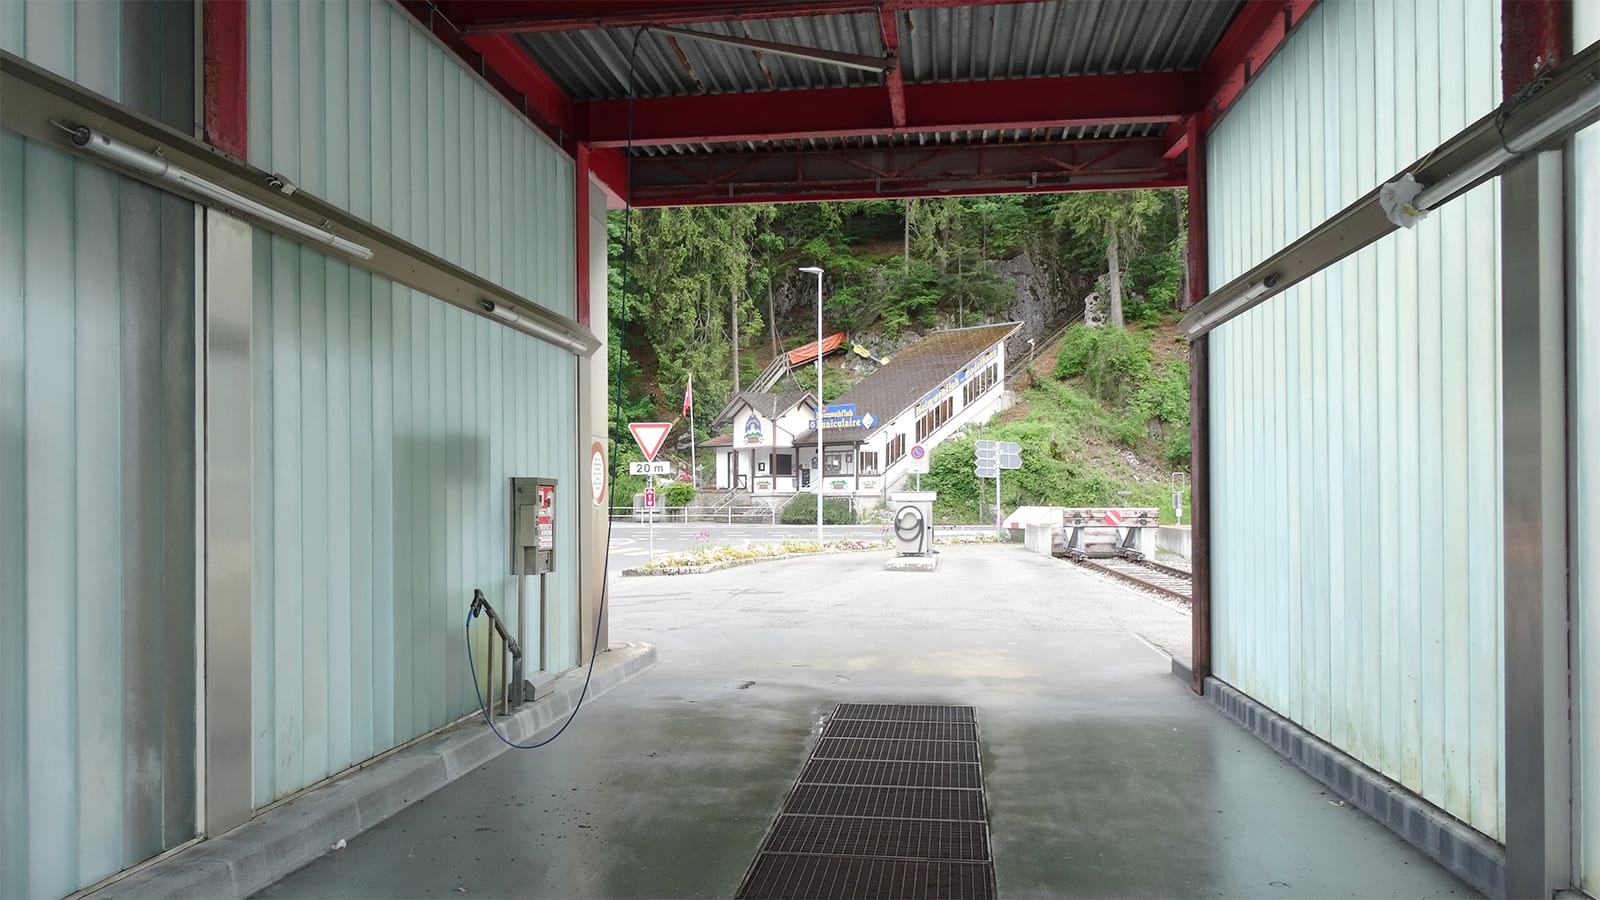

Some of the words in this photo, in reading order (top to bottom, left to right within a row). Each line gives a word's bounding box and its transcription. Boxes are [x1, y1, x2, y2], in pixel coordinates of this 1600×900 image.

[820, 418, 861, 429] uniculaire
[636, 463, 651, 473] 20
[654, 465, 664, 473] m
